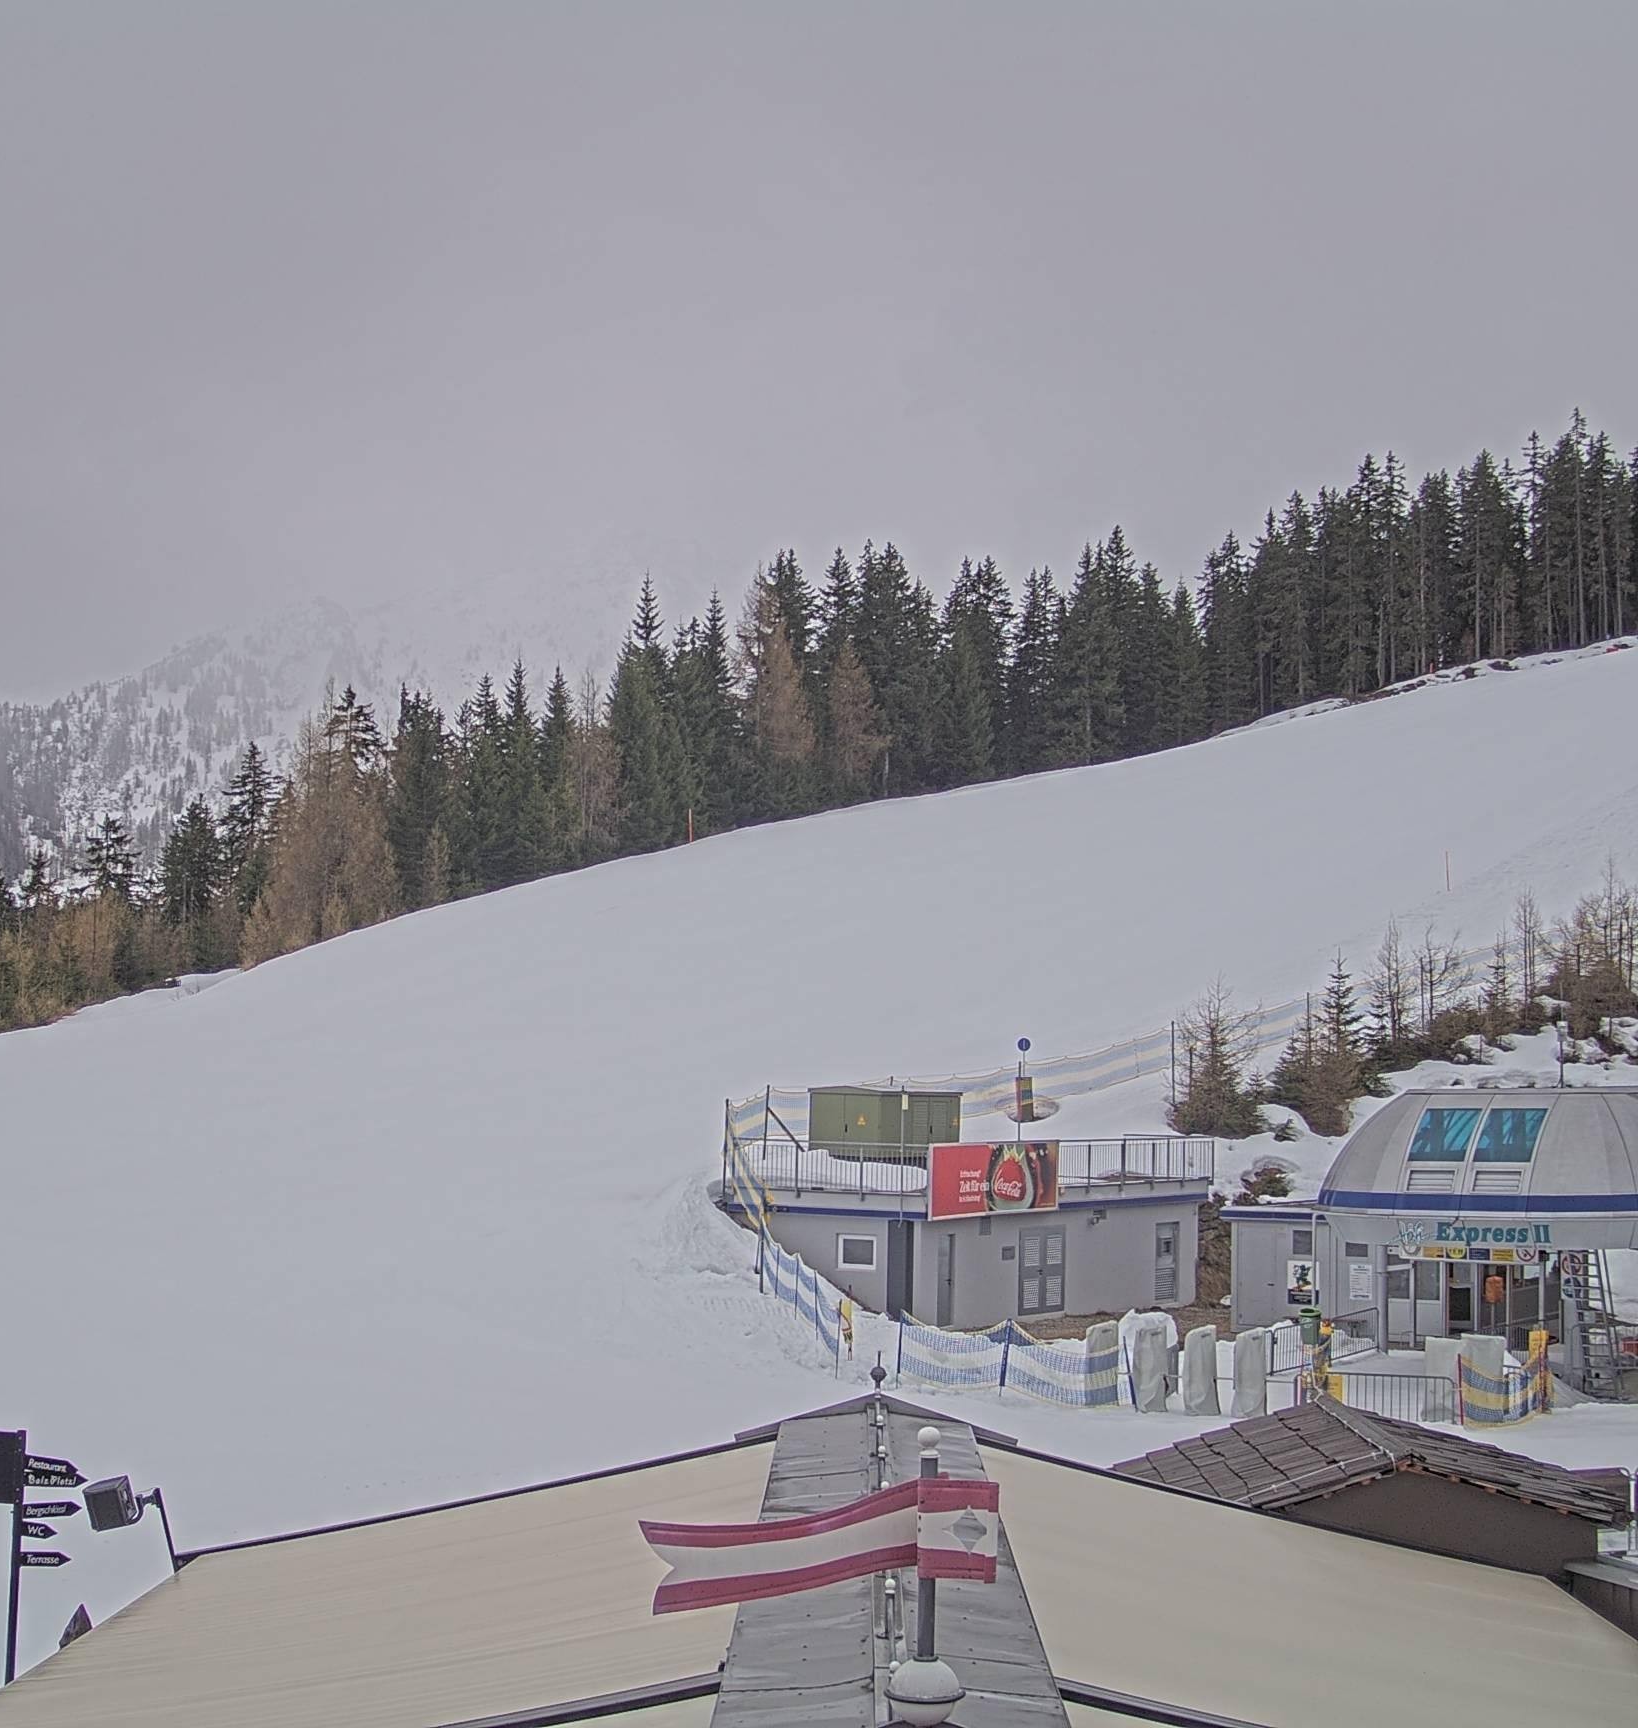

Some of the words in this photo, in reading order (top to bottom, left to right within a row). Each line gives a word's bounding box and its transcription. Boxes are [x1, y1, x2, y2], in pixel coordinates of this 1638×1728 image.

[1436, 1222, 1529, 1244] Express
[1533, 1224, 1551, 1243] II
[28, 1459, 66, 1472] Restaurant
[27, 1525, 46, 1536] WC
[26, 1554, 60, 1565] Terrasse
